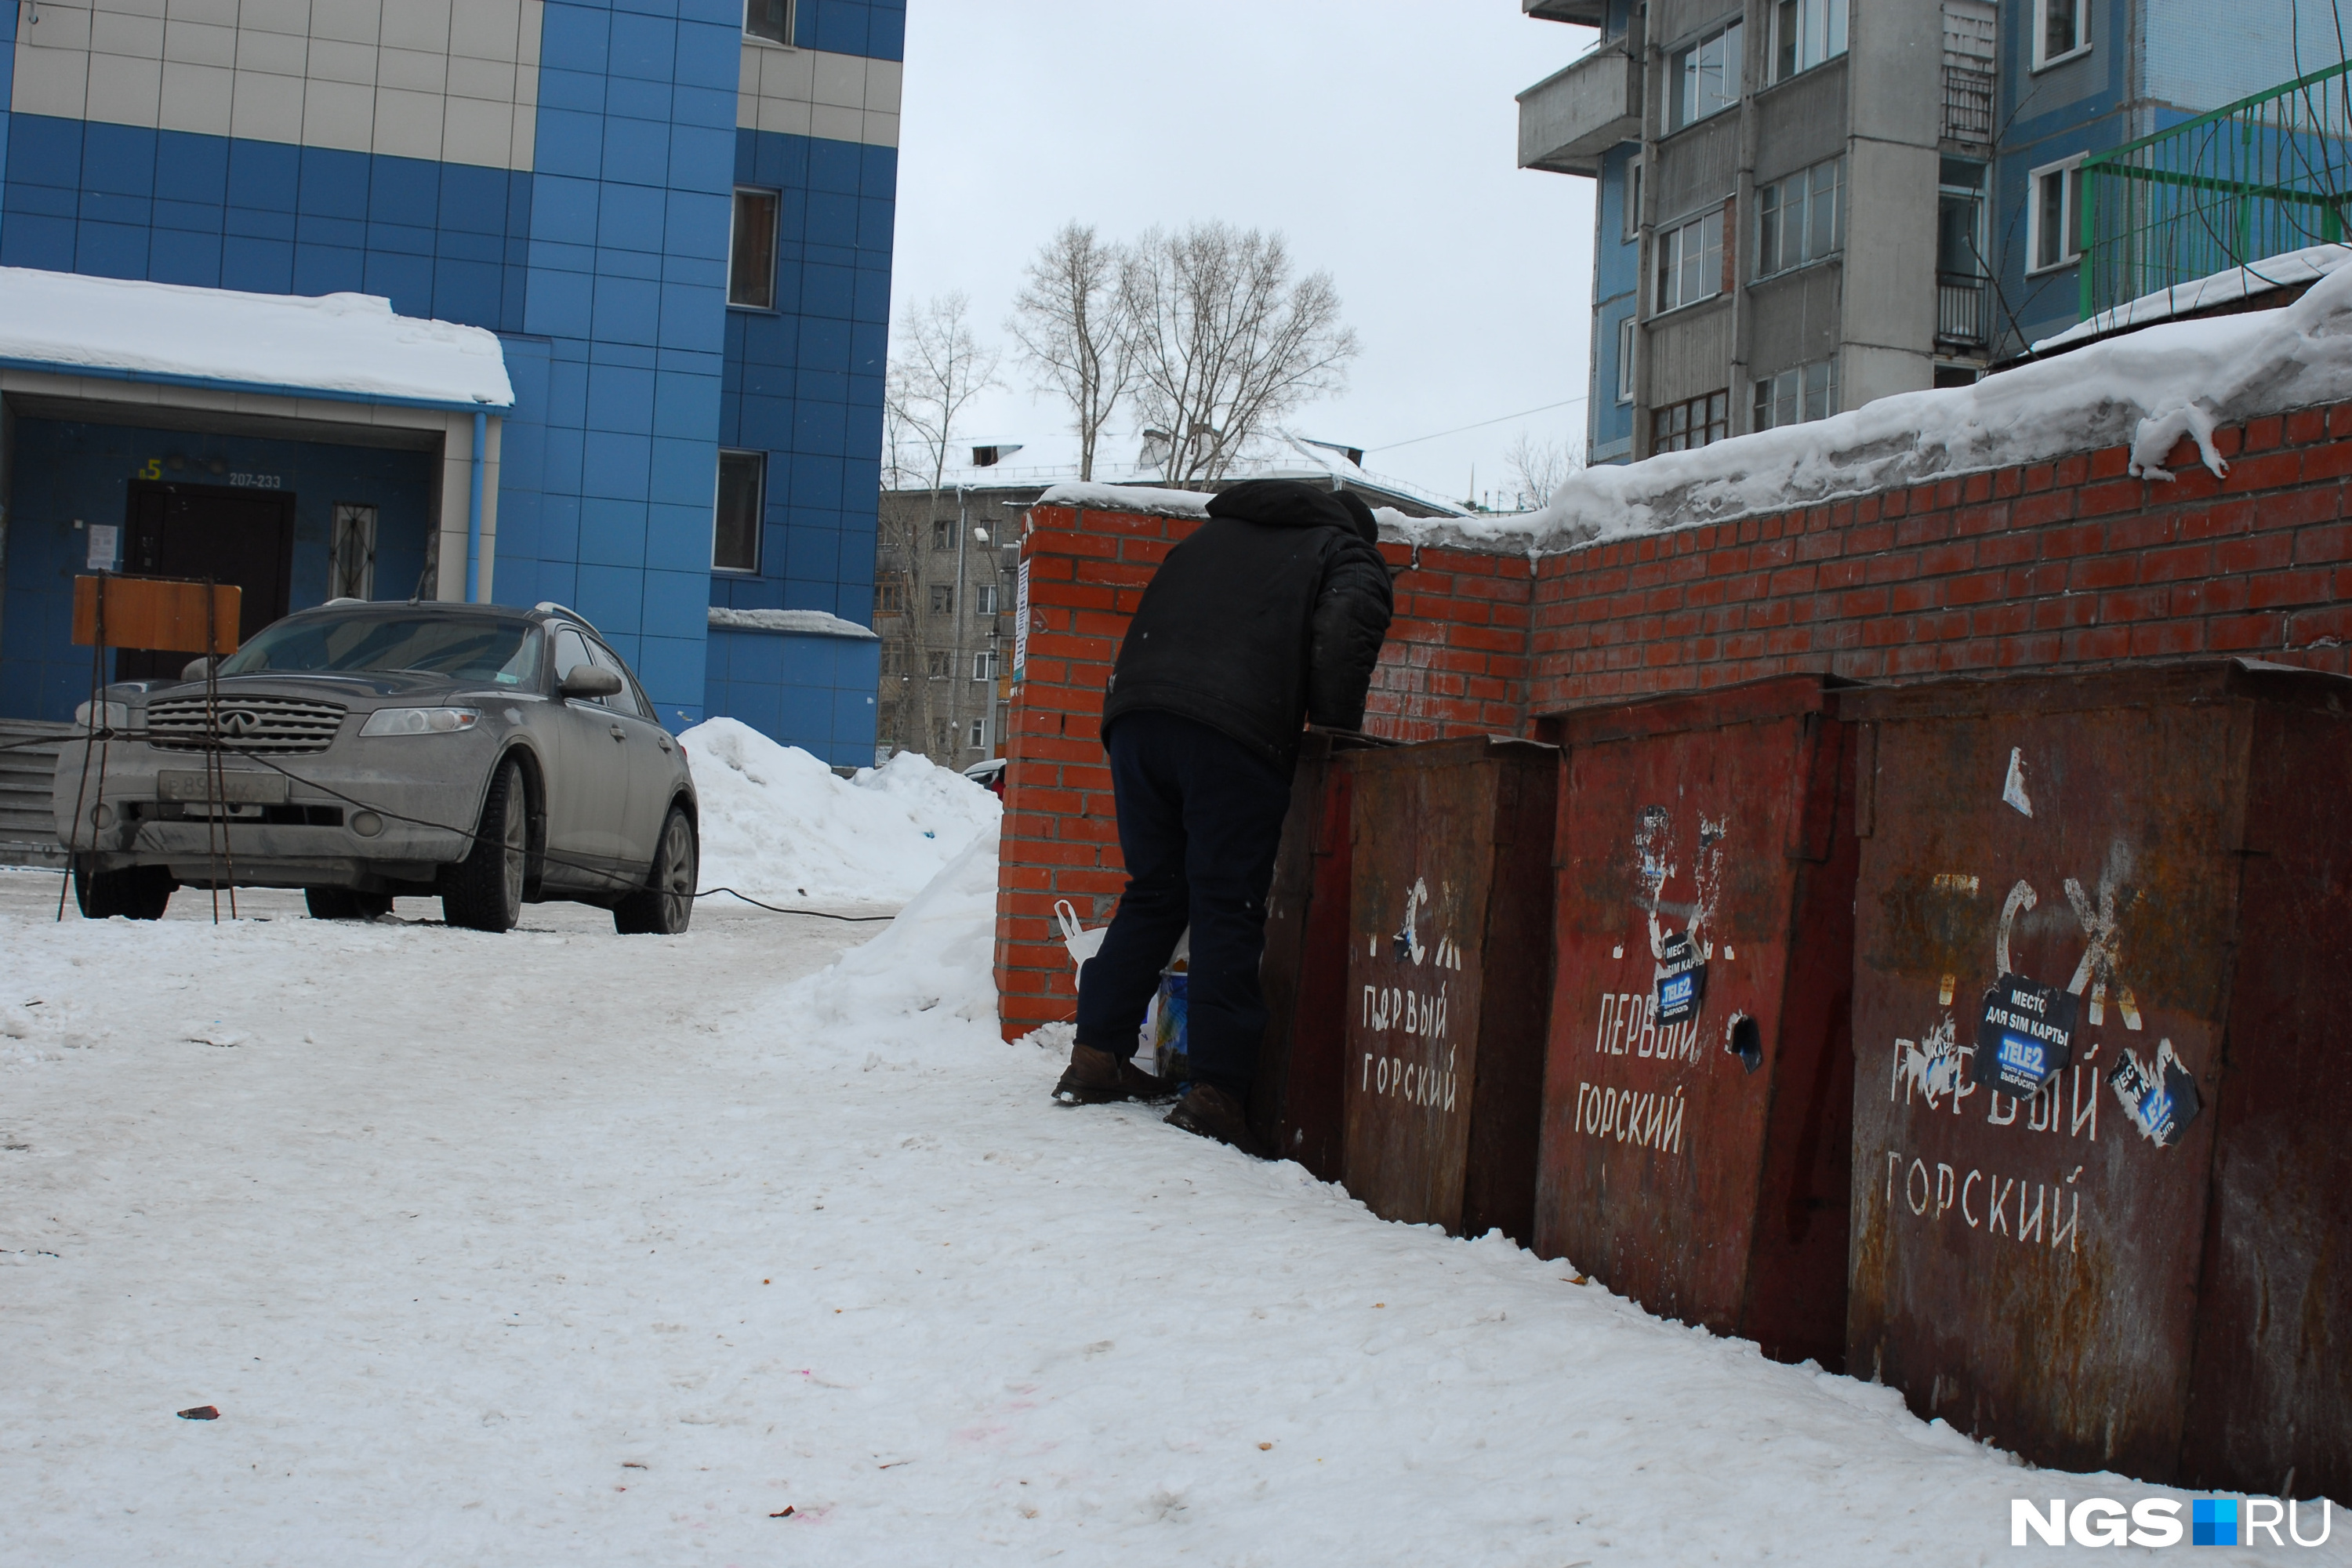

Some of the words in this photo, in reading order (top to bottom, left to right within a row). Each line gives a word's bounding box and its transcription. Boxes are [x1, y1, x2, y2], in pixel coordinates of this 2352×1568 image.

[230, 473, 281, 488] 207-233
[1666, 942, 1686, 959] МЕСТ
[2011, 989, 2047, 1014] МЕСТО
[1985, 1006, 2009, 1025] ДЛЯ
[2009, 1013, 2029, 1033] SIM
[2030, 1020, 2069, 1047] КАРТЫ
[1363, 1044, 1456, 1112] ГОРСКИЙ
[1575, 1082, 1685, 1154] ГОРСКИЙ
[1887, 1151, 2082, 1253] ГОРСКИЙ
